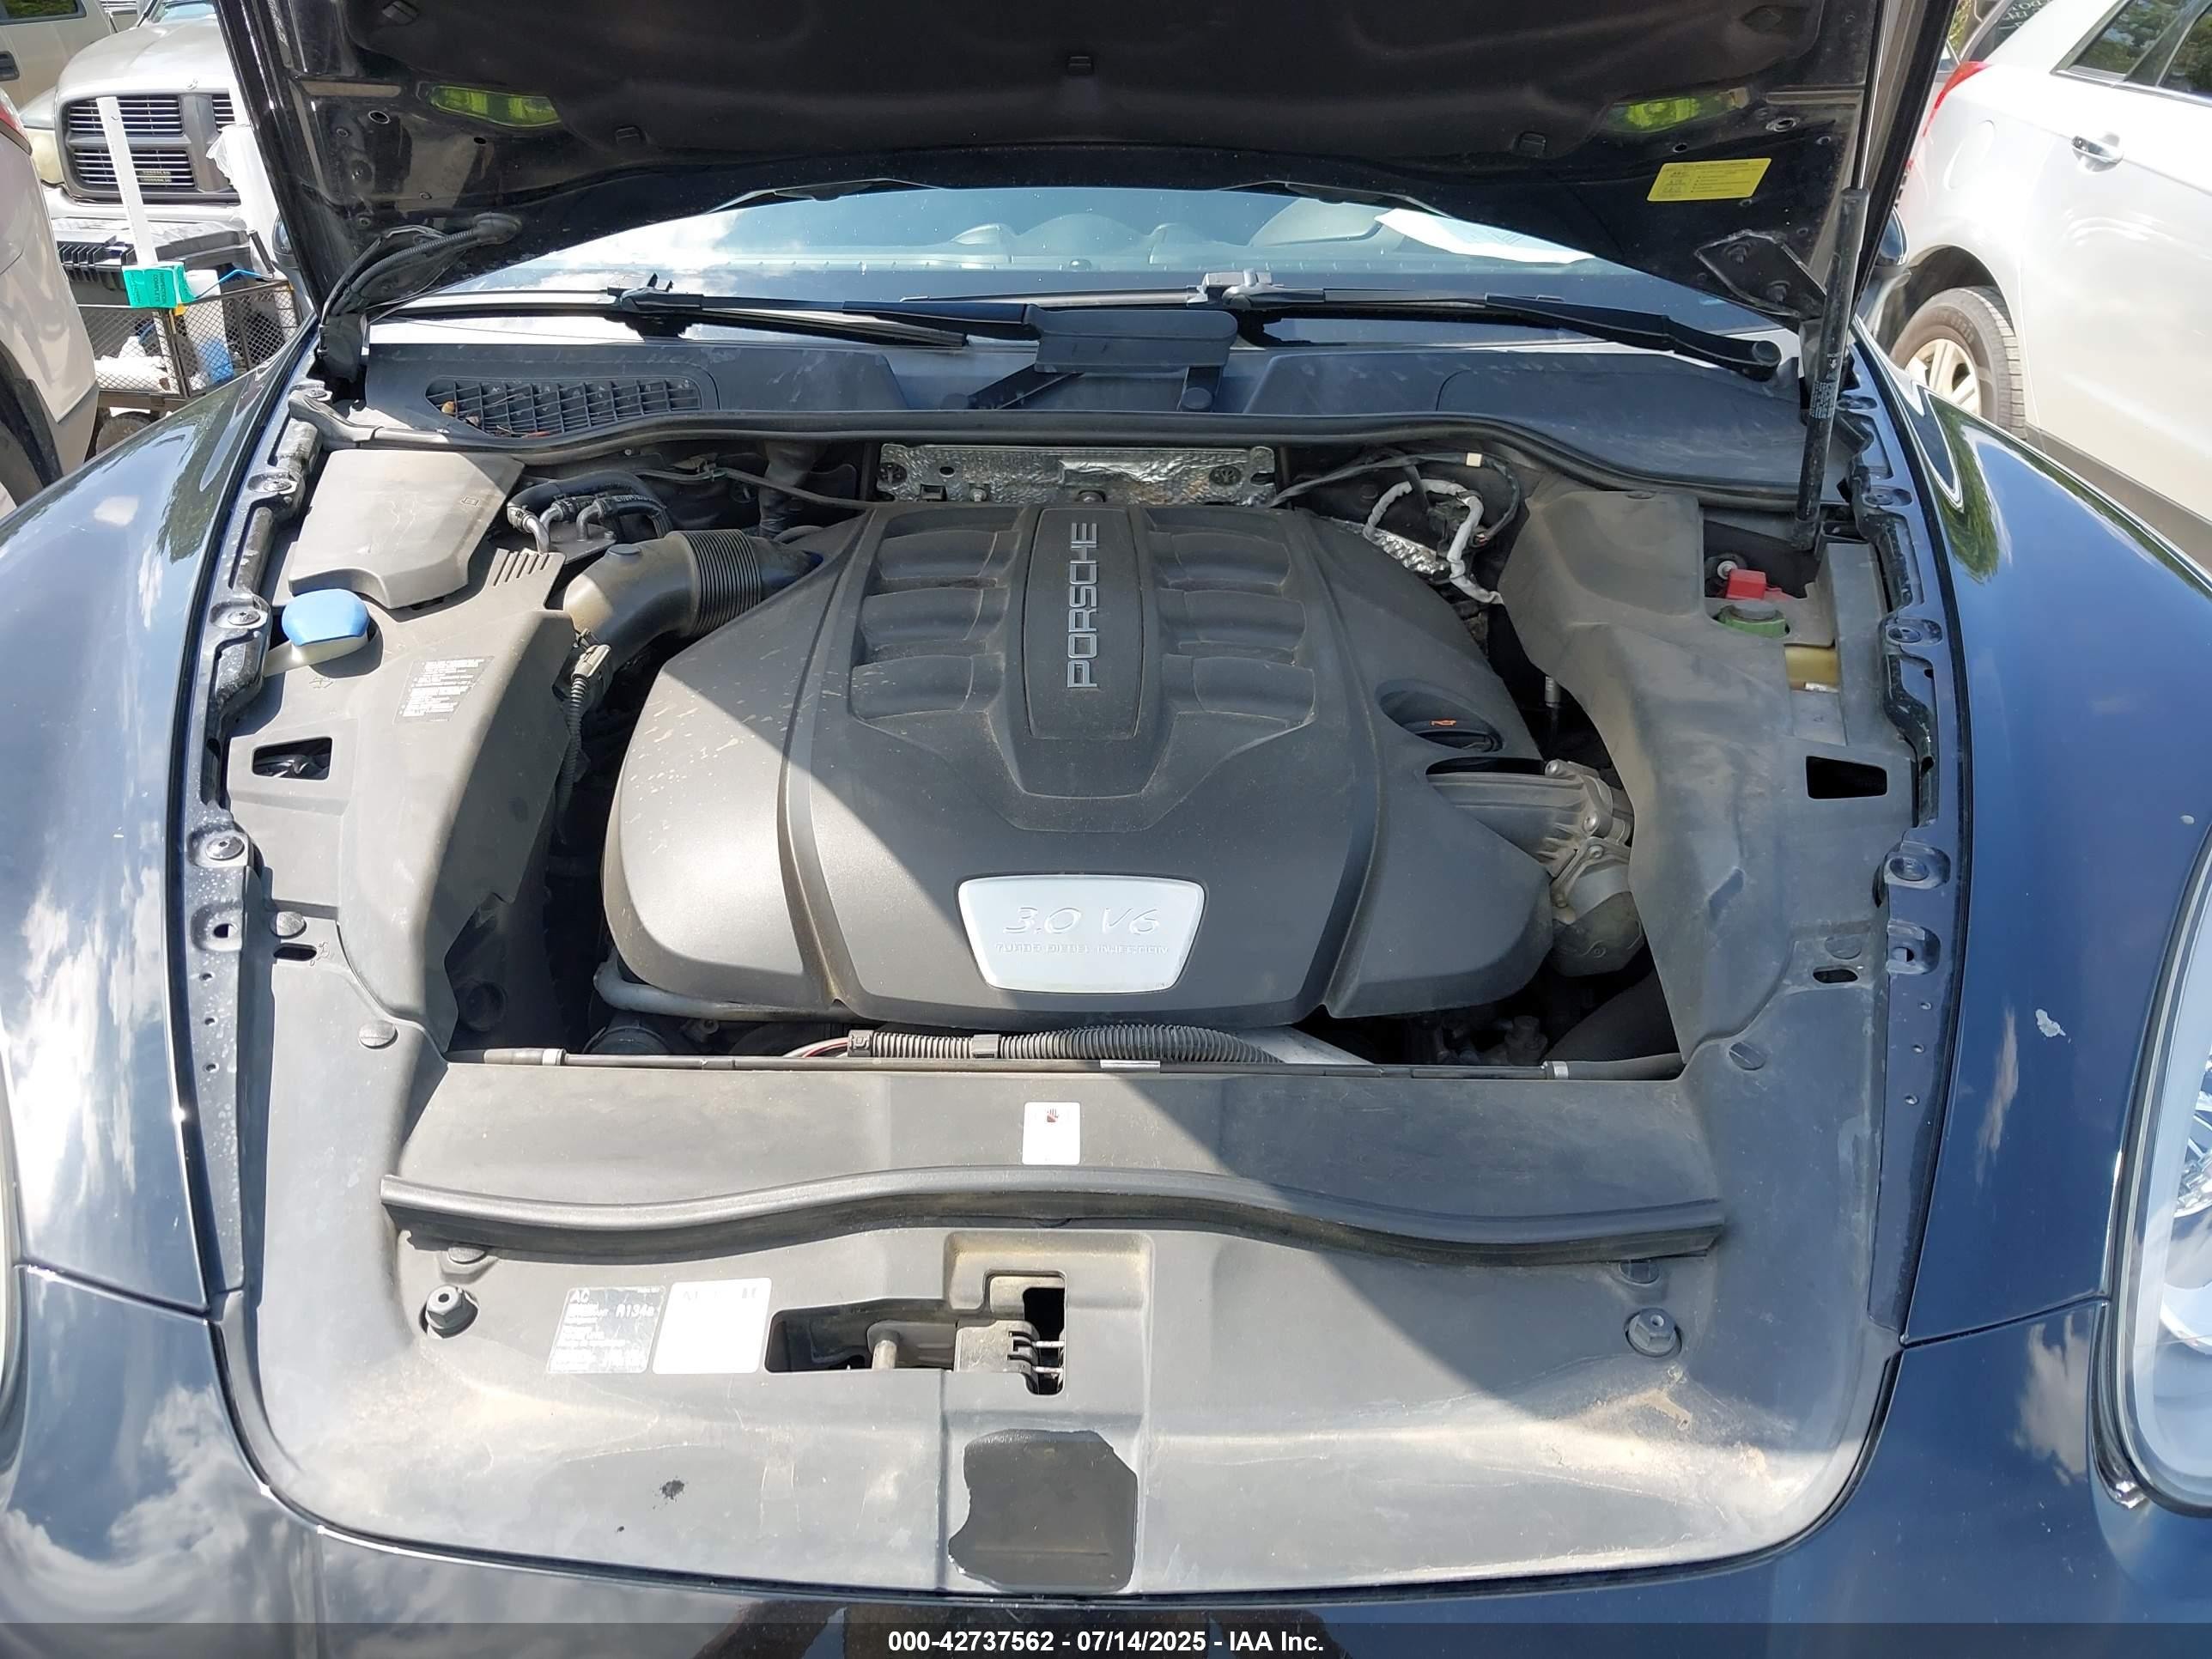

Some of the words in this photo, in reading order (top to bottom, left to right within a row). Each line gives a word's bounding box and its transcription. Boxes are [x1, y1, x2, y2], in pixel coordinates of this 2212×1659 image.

[1067, 522, 1098, 688] PORSCHE
[1002, 907, 1082, 935] 3.0
[1103, 907, 1160, 936] V6
[569, 1290, 591, 1304] AC
